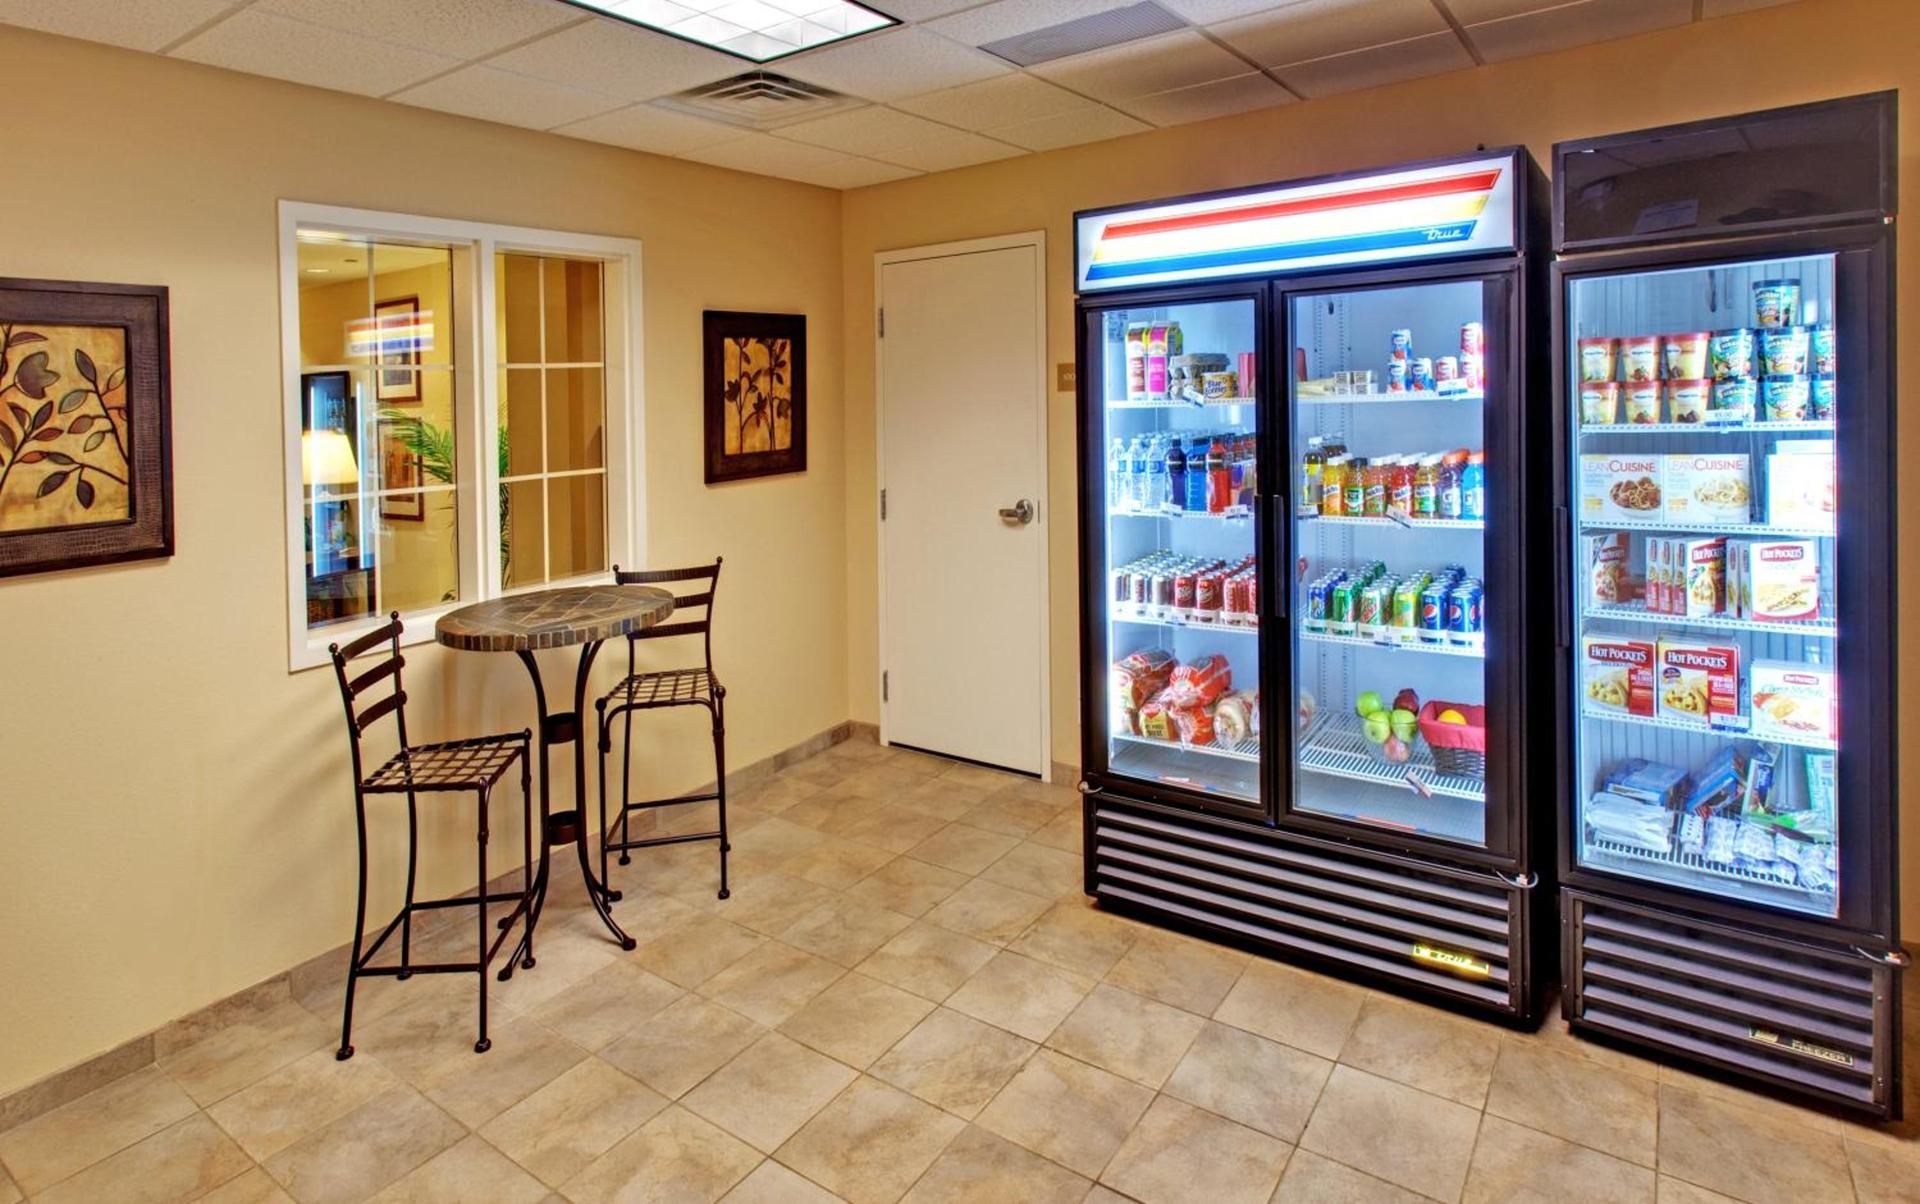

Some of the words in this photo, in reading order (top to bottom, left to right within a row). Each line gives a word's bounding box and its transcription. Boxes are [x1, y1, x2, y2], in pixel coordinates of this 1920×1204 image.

[1609, 459, 1656, 473] CUISINE
[1694, 458, 1743, 471] CUISINE
[1591, 646, 1608, 657] HOT
[1608, 648, 1647, 662] POCKETS
[1667, 652, 1687, 664] HOT
[1686, 653, 1727, 668] POCKETS
